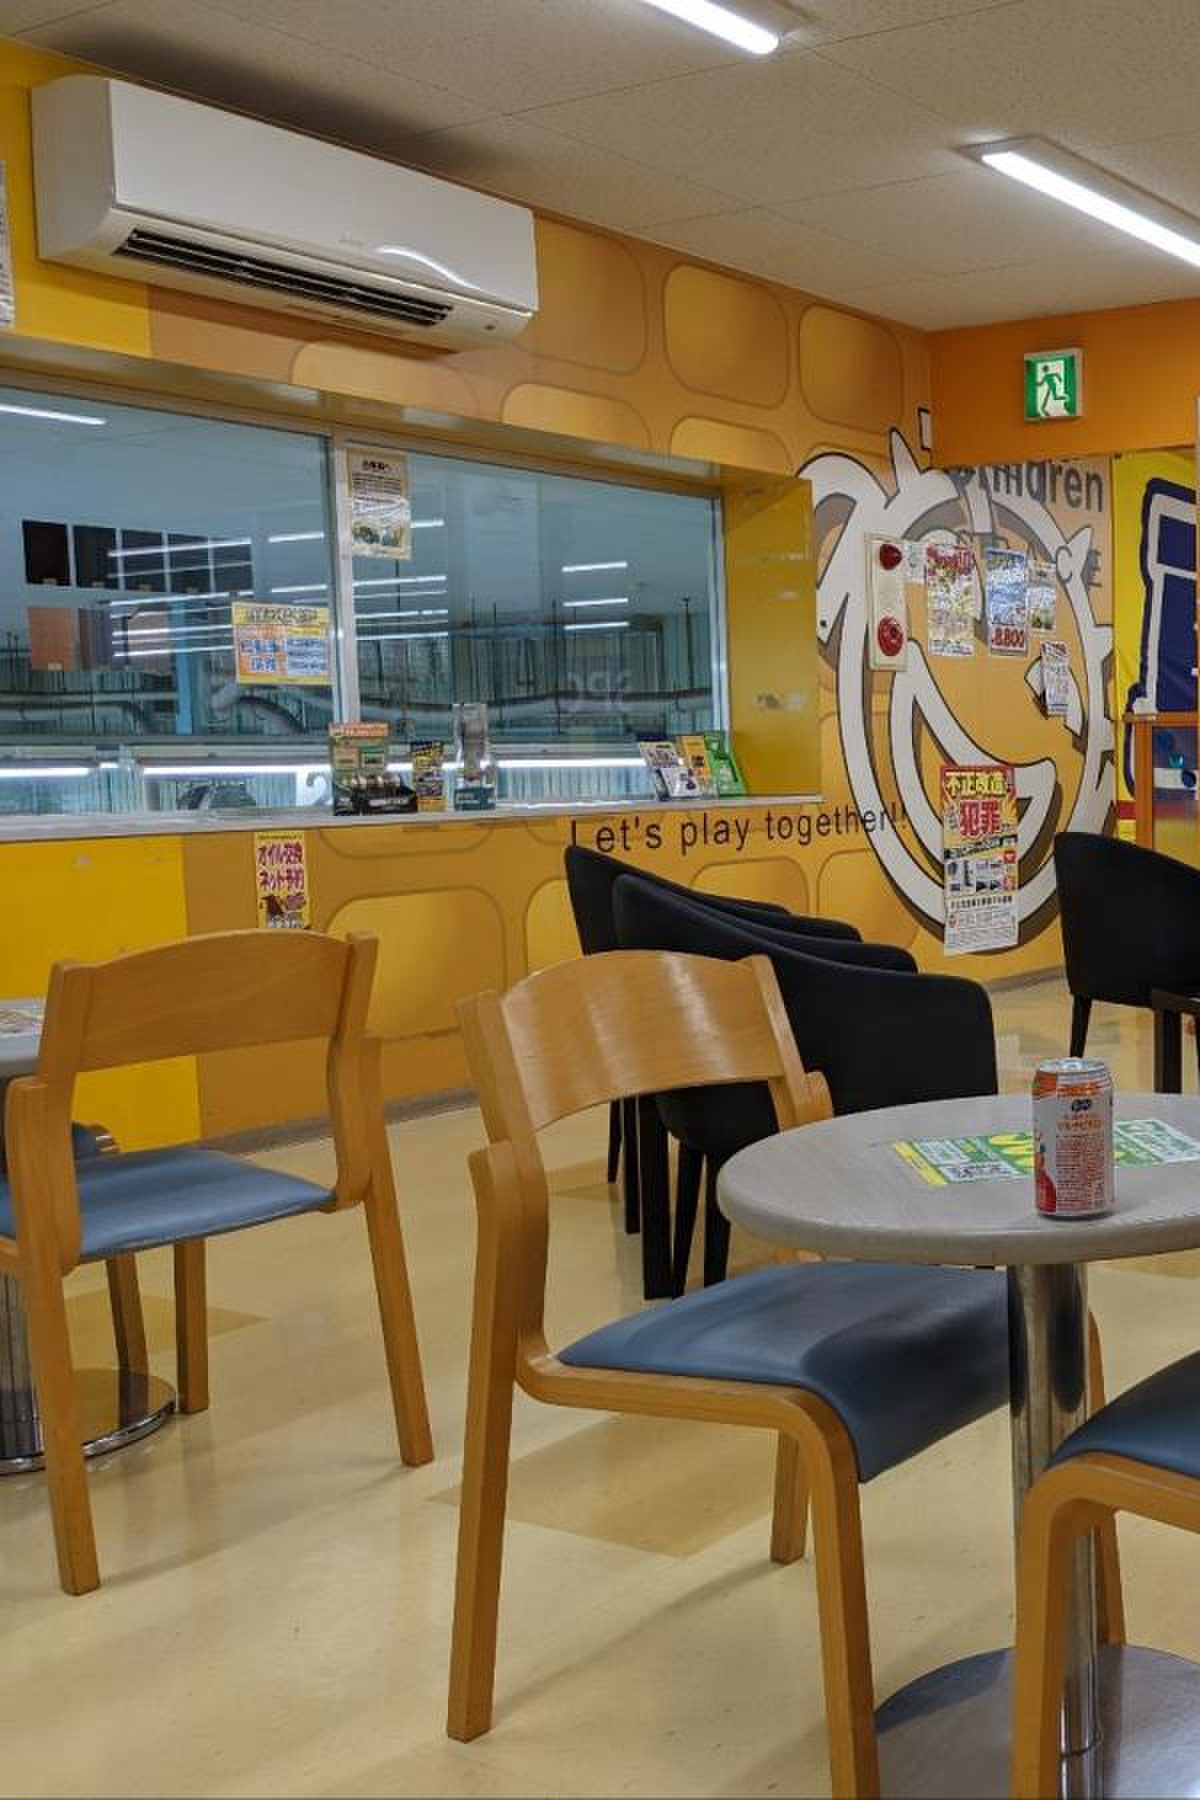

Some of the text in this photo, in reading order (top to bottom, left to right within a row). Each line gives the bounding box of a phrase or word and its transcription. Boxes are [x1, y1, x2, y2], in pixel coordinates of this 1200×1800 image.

[681, 812, 750, 856] play
[959, 800, 1001, 836] 犯罪
[257, 841, 304, 866] オイル交換
